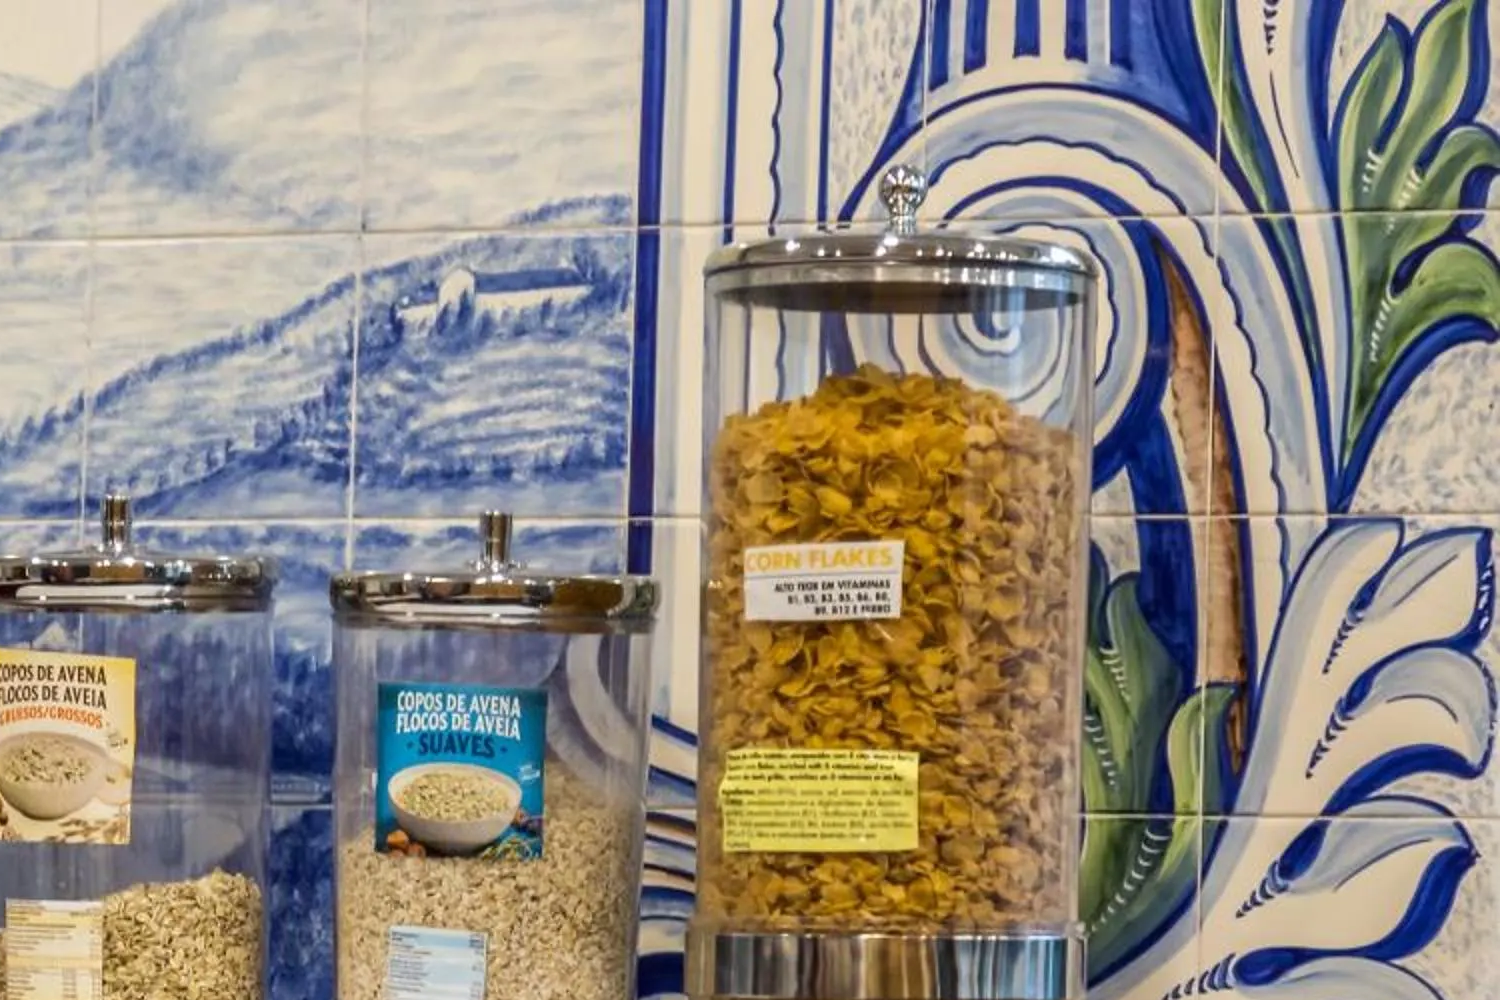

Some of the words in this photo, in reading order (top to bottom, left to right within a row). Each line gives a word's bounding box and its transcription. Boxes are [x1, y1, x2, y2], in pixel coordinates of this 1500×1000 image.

[745, 552, 800, 573] CORN
[809, 547, 894, 568] FLAKES
[774, 582, 794, 593] ALTO
[821, 580, 835, 591] EM
[837, 579, 890, 589] VITAMINAS
[37, 664, 55, 682] DE
[58, 664, 107, 686] AVENA
[41, 685, 59, 701] DE
[63, 686, 107, 709] AVEIA
[397, 690, 443, 712] COPOS
[446, 692, 466, 713] DE
[469, 693, 521, 718] AVENA
[396, 711, 448, 735] FLOCOS
[451, 713, 471, 732] DE
[474, 715, 521, 741] AVEIA
[418, 733, 496, 759] SUAVES
